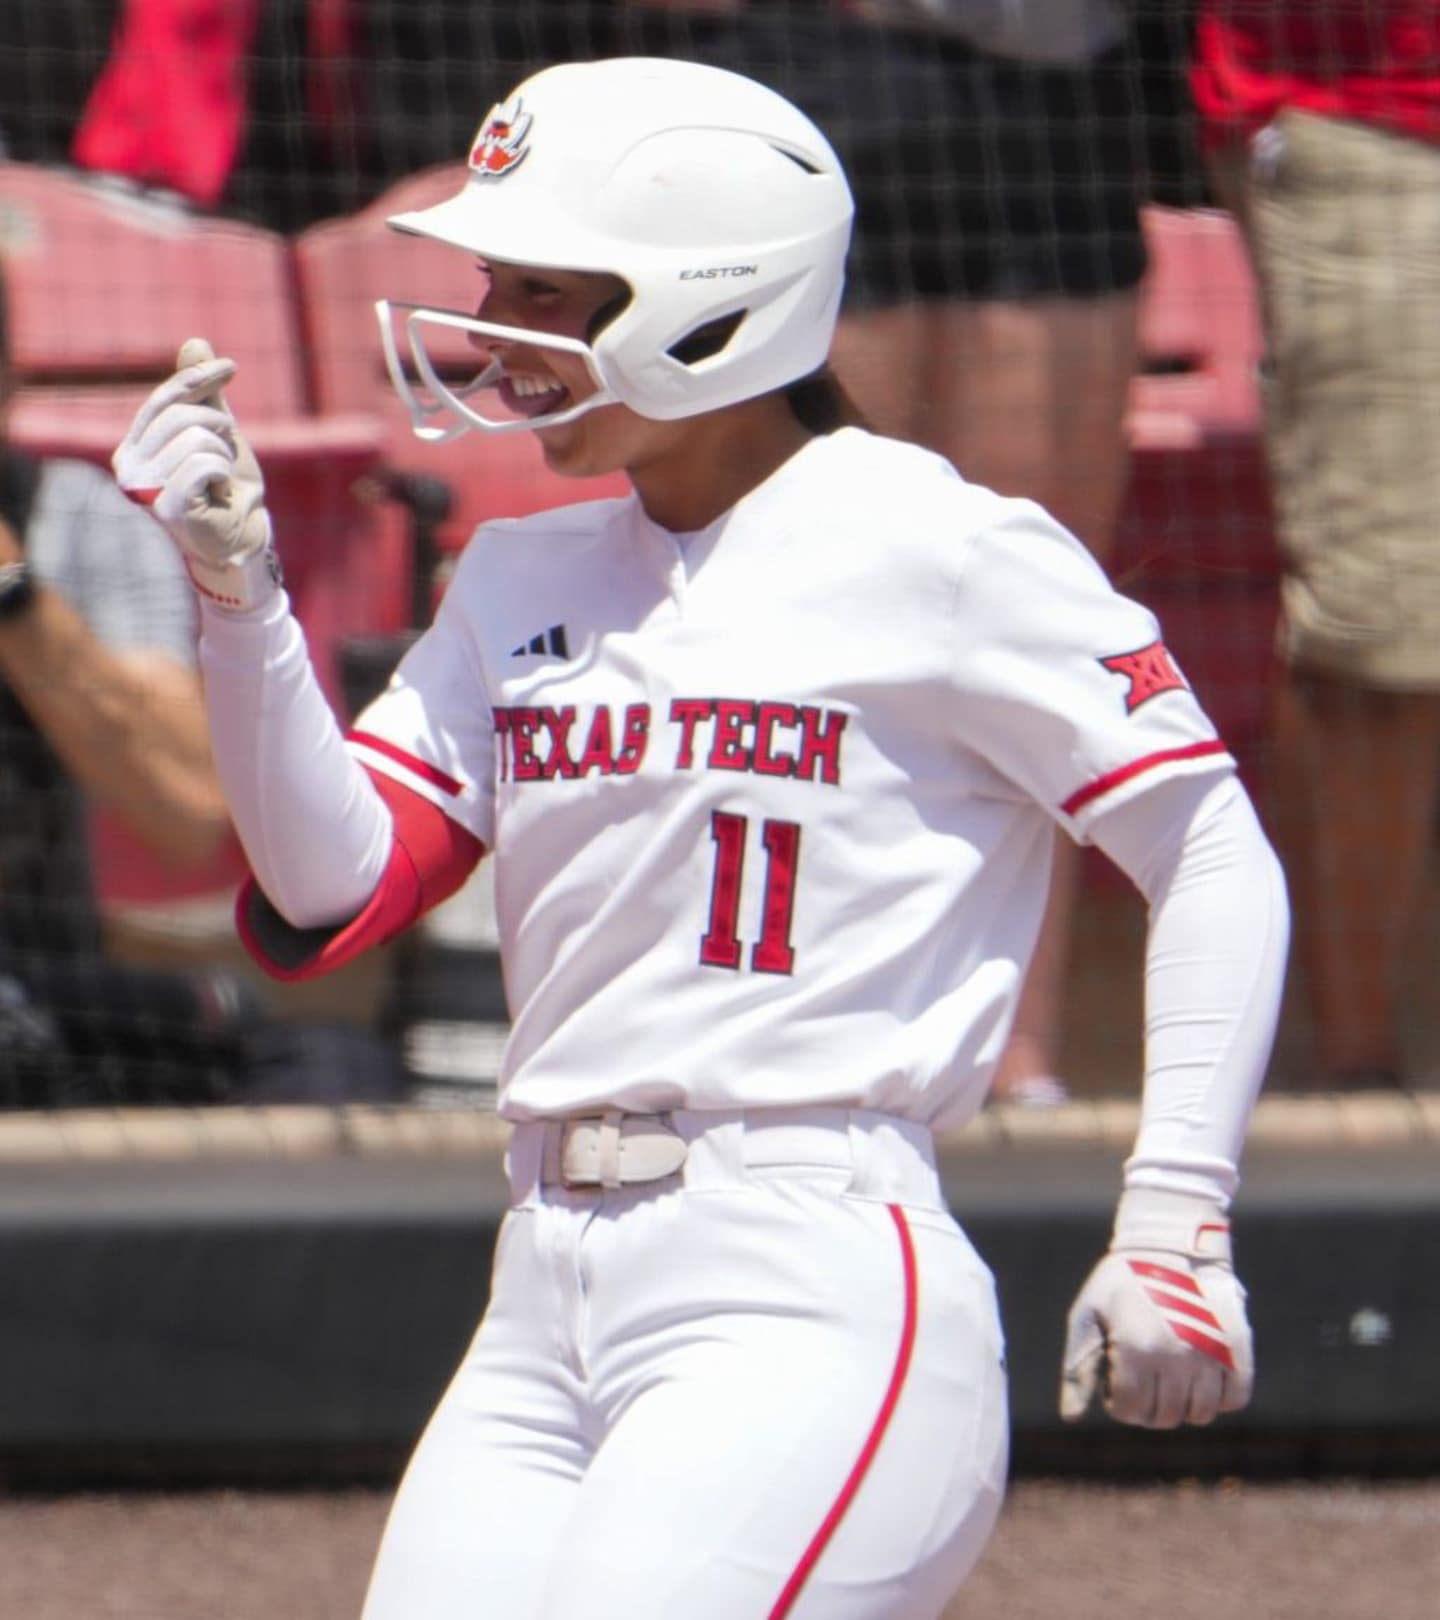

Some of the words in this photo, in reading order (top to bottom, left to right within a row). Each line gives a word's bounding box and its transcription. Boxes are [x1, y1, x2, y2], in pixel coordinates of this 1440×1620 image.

[678, 264, 758, 281] EASTON
[492, 703, 651, 783] TEXAS
[669, 698, 848, 786] TECH
[699, 809, 801, 977] 11
